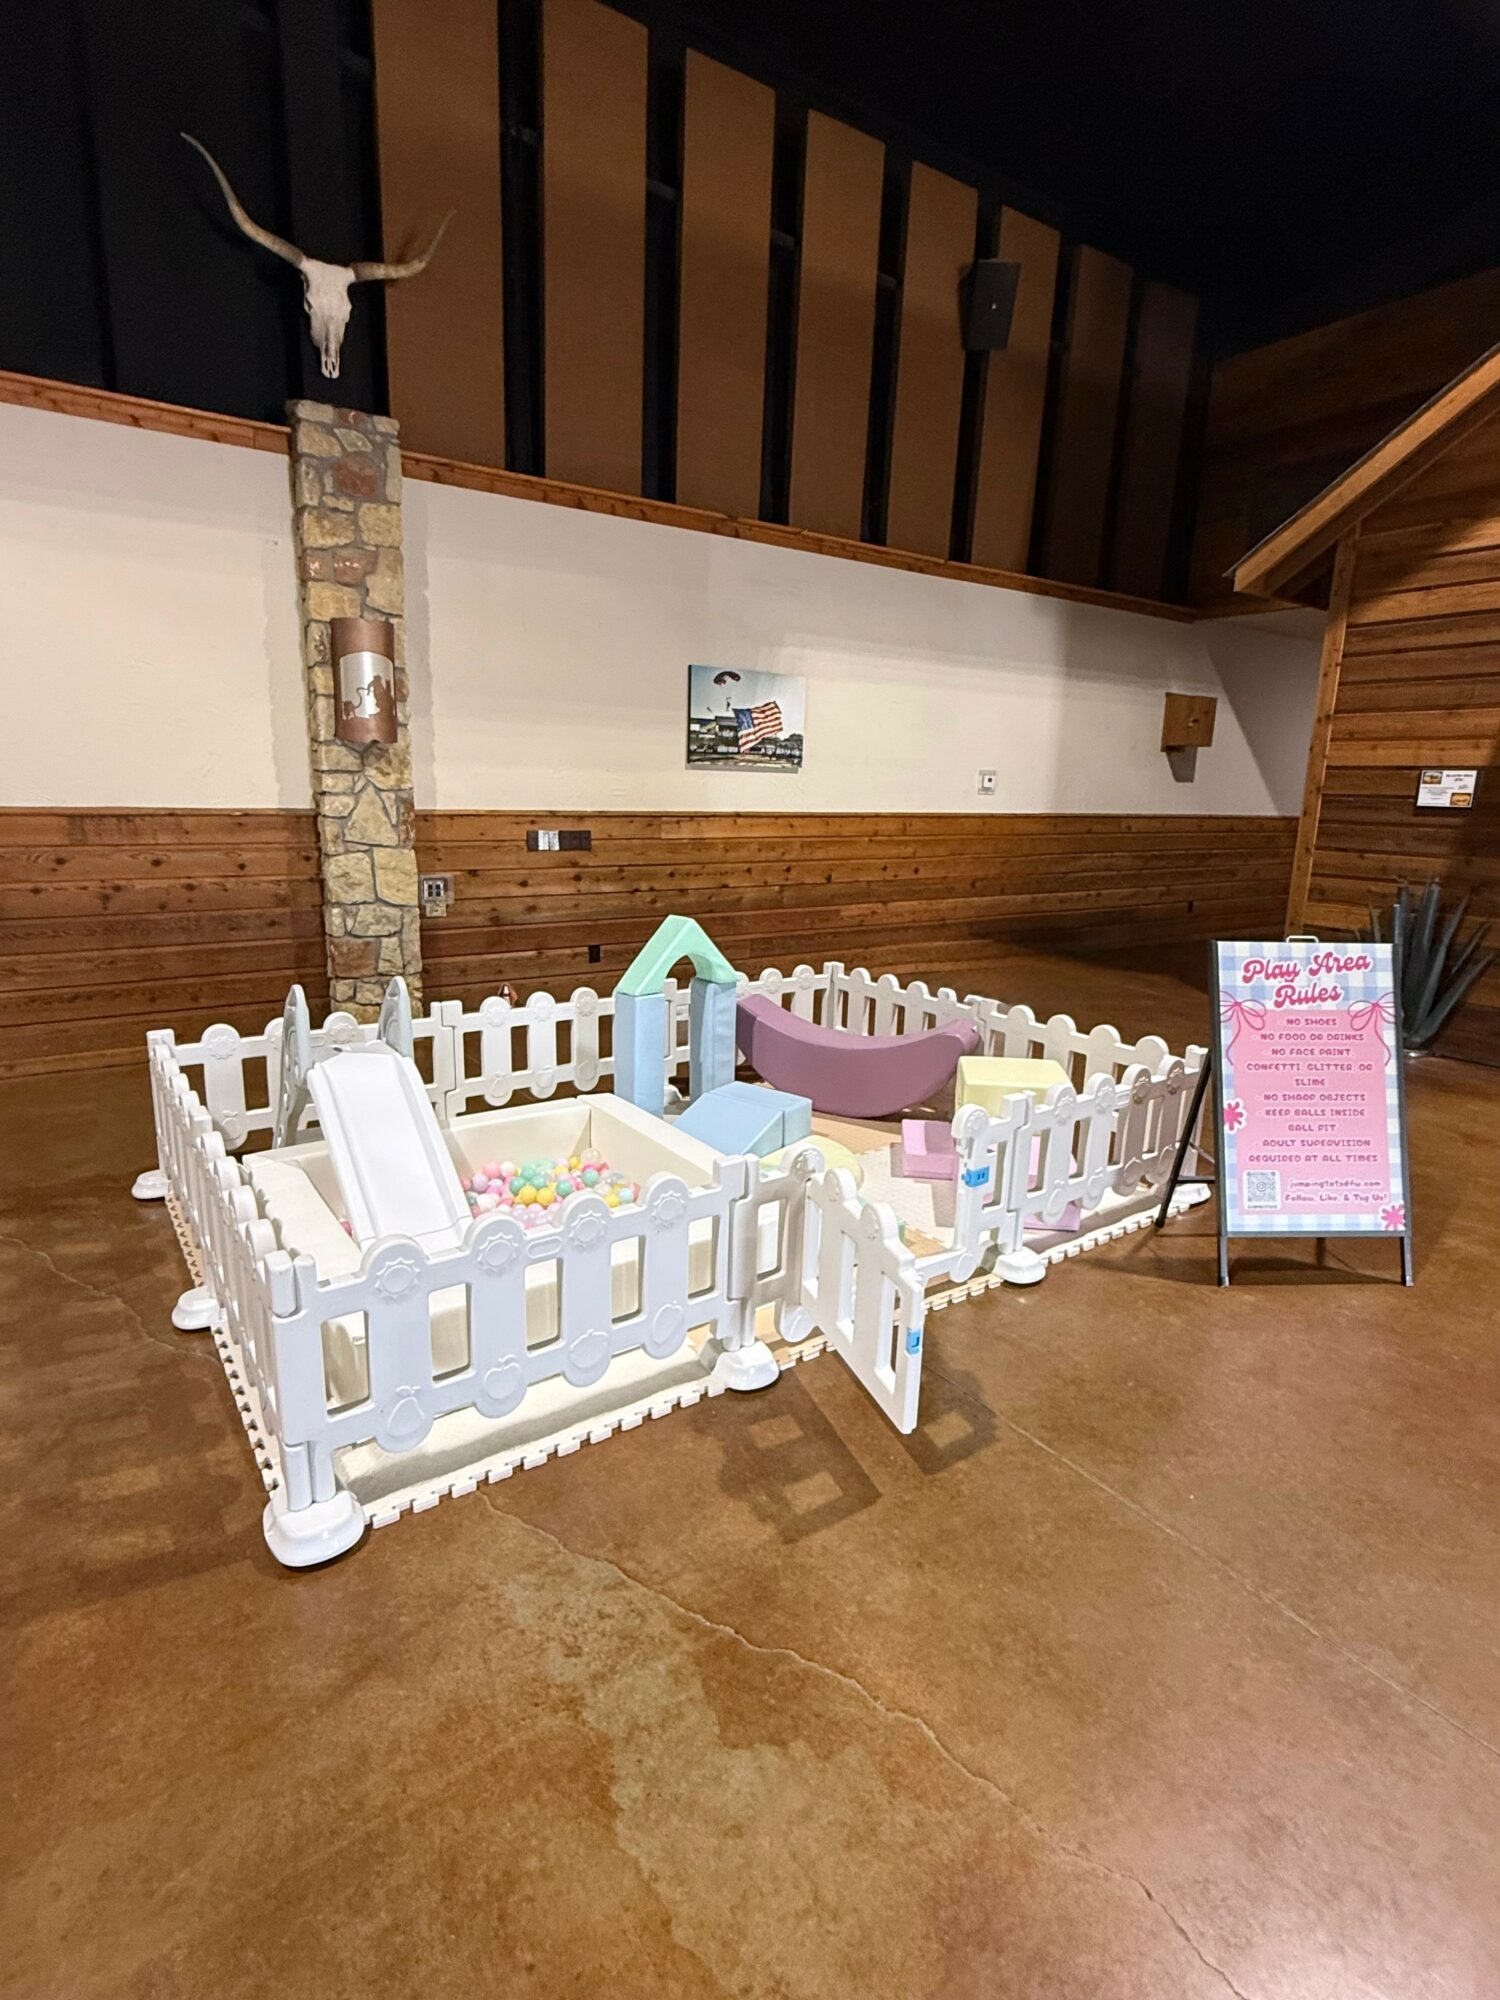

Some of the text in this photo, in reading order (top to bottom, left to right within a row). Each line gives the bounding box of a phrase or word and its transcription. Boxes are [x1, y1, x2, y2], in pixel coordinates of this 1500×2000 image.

[1242, 951, 1371, 984] Play Area
[1273, 983, 1342, 1009] Rules
[1286, 1018, 1337, 1026] NO SHOES
[1260, 1033, 1364, 1041] NO FOOD OR DRINKS
[1271, 1048, 1286, 1056] NO
[1289, 1048, 1316, 1056] FACE
[1358, 1063, 1373, 1072] OR
[1294, 1078, 1326, 1087] SLIME
[1263, 1093, 1366, 1102] NO SHARP OBJECTS
[1264, 1108, 1366, 1117] KEEP BALLS INSIDE
[1287, 1124, 1337, 1132] BALL PIT
[1262, 1139, 1371, 1147] ADULT SUPERVISION
[1248, 1154, 1379, 1163] REQUIRED AT ALL TIMES
